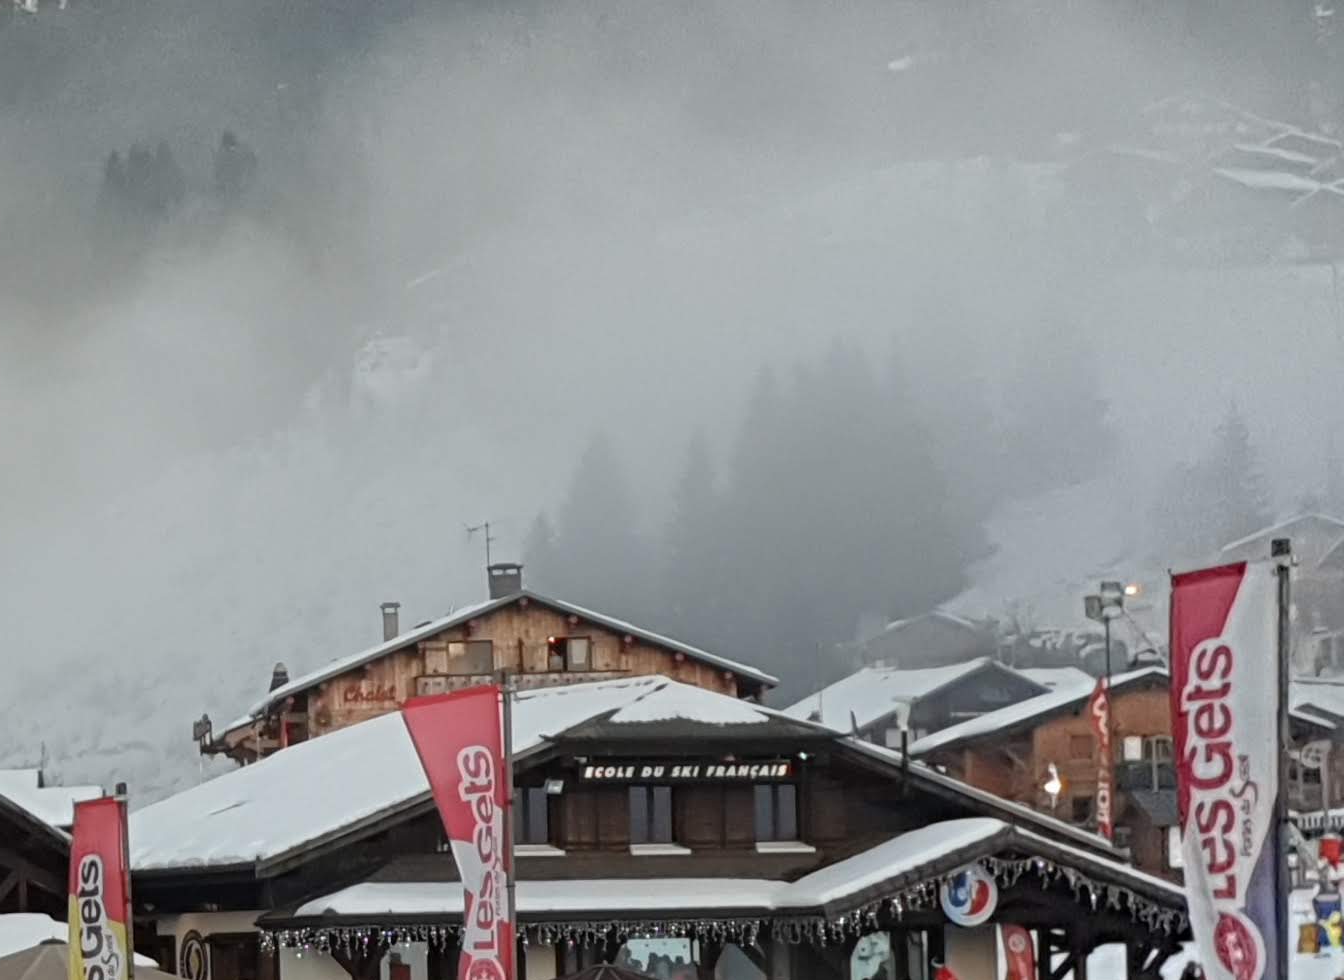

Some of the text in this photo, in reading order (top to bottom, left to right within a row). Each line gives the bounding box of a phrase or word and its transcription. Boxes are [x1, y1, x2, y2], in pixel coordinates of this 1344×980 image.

[584, 764, 787, 779] ECOLE DU SKI FRANÇAIS
